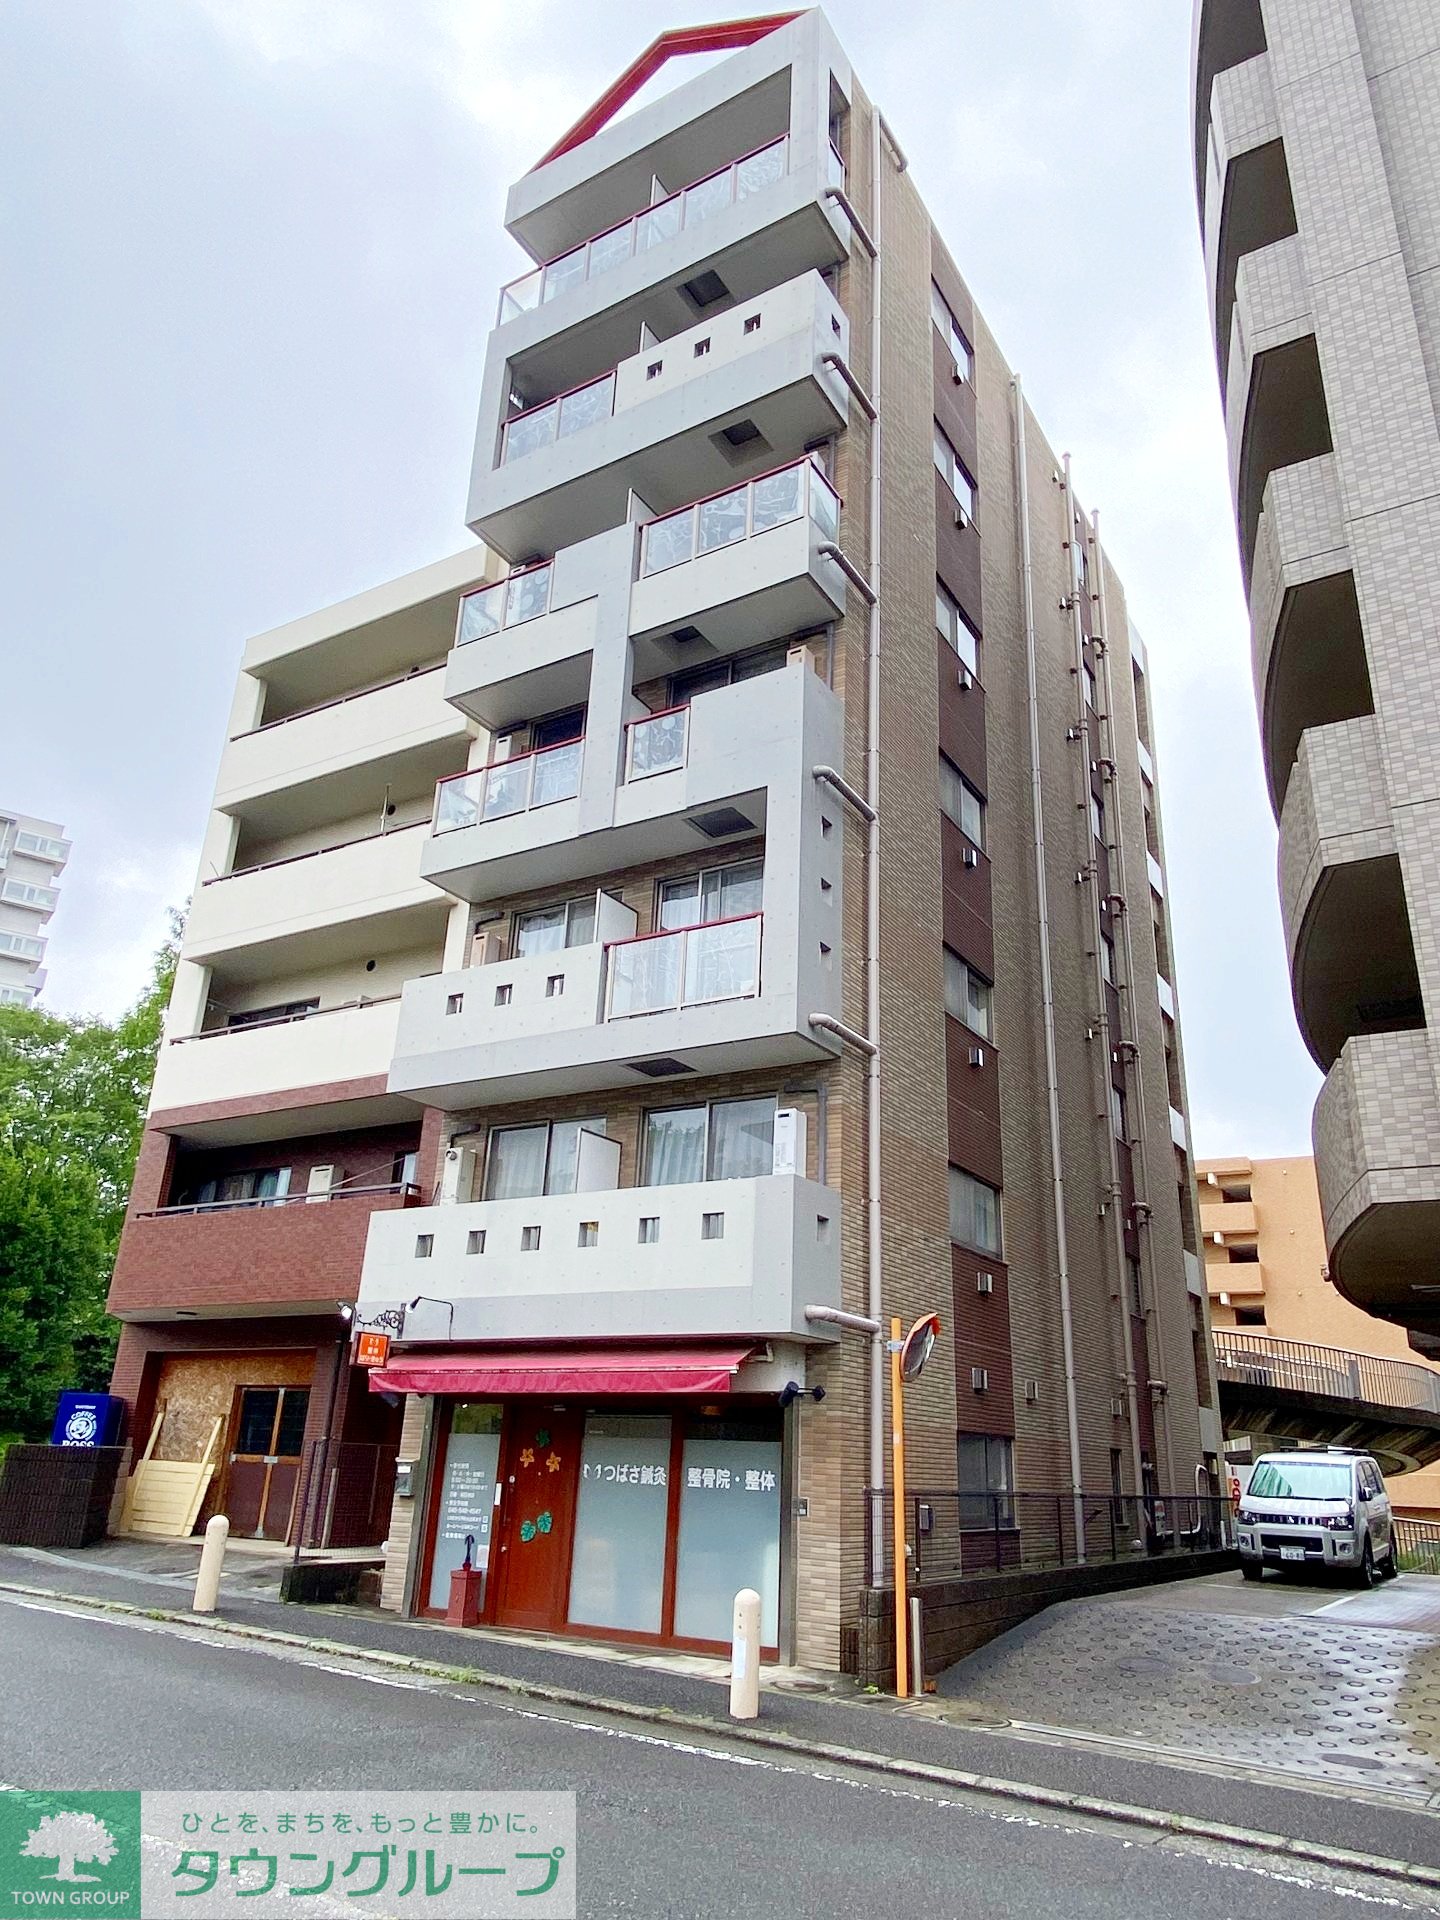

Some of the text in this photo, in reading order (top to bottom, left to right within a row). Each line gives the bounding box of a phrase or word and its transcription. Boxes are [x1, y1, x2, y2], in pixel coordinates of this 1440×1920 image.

[71, 1411, 96, 1421] COFFEE
[687, 1467, 776, 1491] 整骨院・整体
